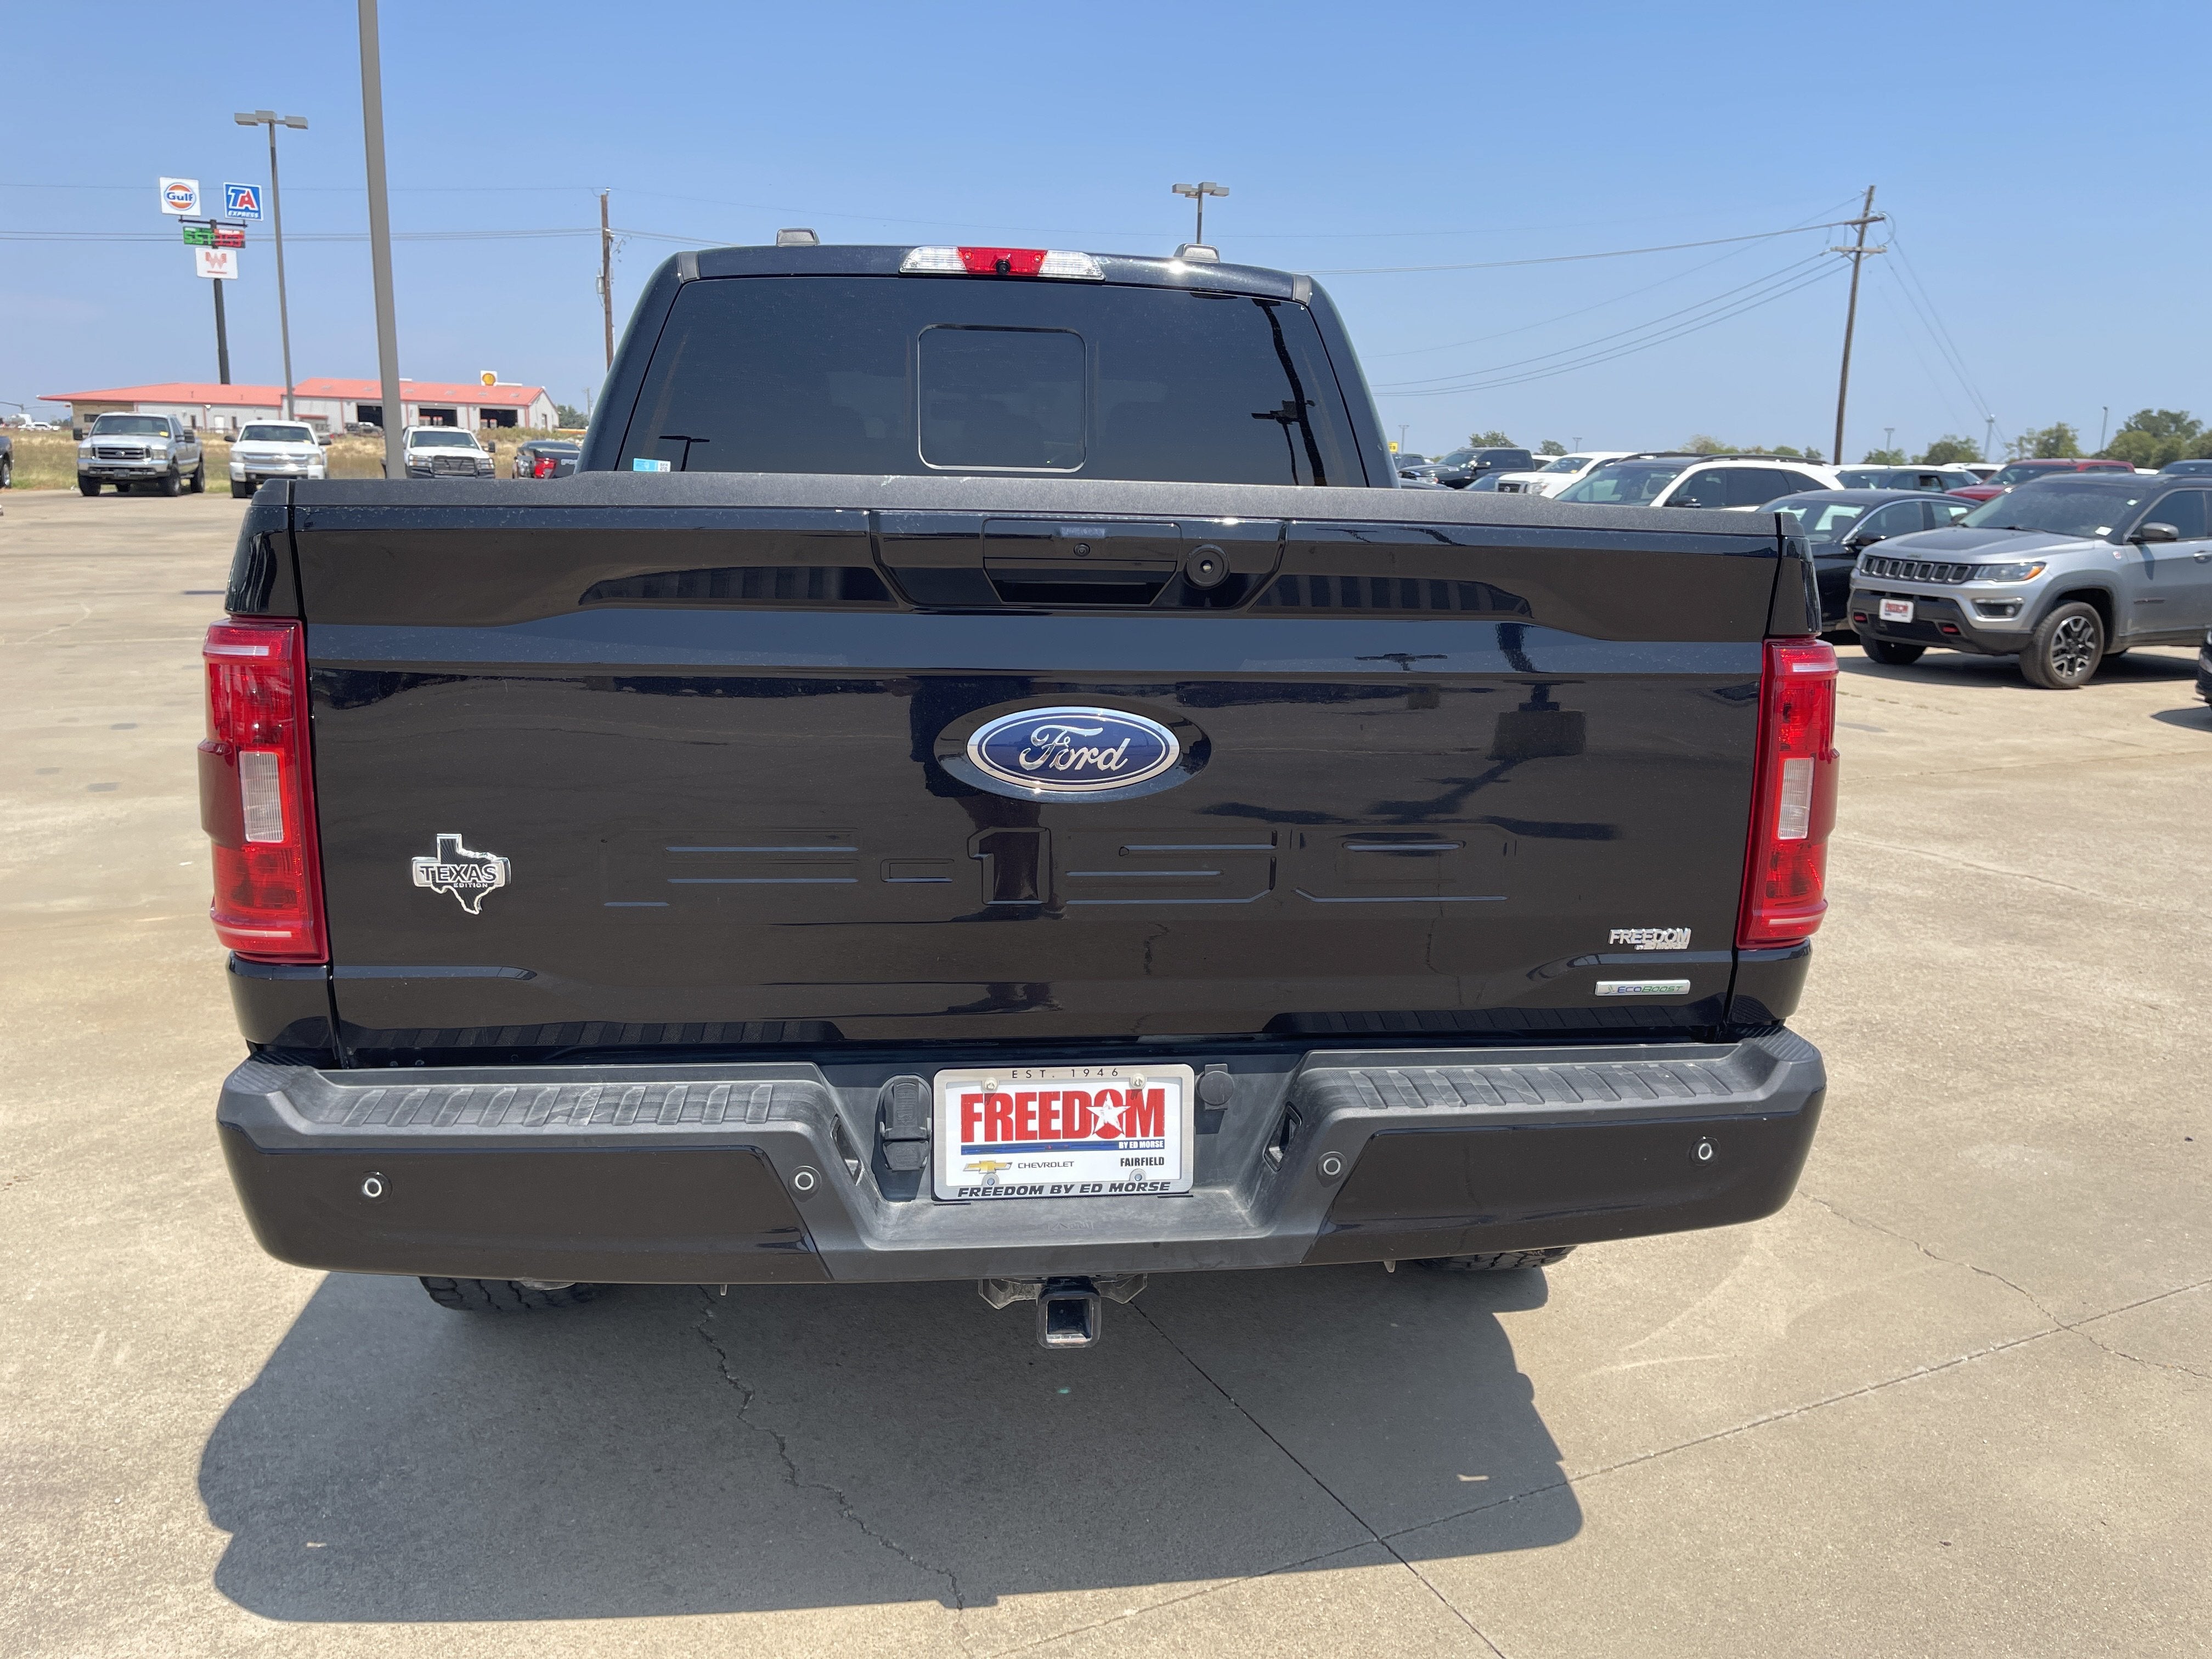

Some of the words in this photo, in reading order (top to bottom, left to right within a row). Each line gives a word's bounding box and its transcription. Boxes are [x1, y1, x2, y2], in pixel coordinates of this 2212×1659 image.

[166, 192, 193, 201] Gulf
[228, 187, 258, 211] TA
[1019, 724, 1131, 771] Ford
[419, 864, 498, 883] TEXAS
[1608, 927, 1691, 944] FREEDOM
[1012, 1070, 1055, 1079] EST.
[1071, 1068, 1118, 1077] 1946
[961, 1088, 1165, 1143] FREEDOM
[1139, 1140, 1164, 1148] MORSE
[1018, 1161, 1075, 1169] CHEVROLET
[1120, 1156, 1165, 1167] FAIRFIELD
[957, 1185, 1044, 1198] FREEDOM
[1049, 1184, 1074, 1194] BY
[1079, 1183, 1103, 1194] ED
[1109, 1181, 1171, 1193] MORSE
